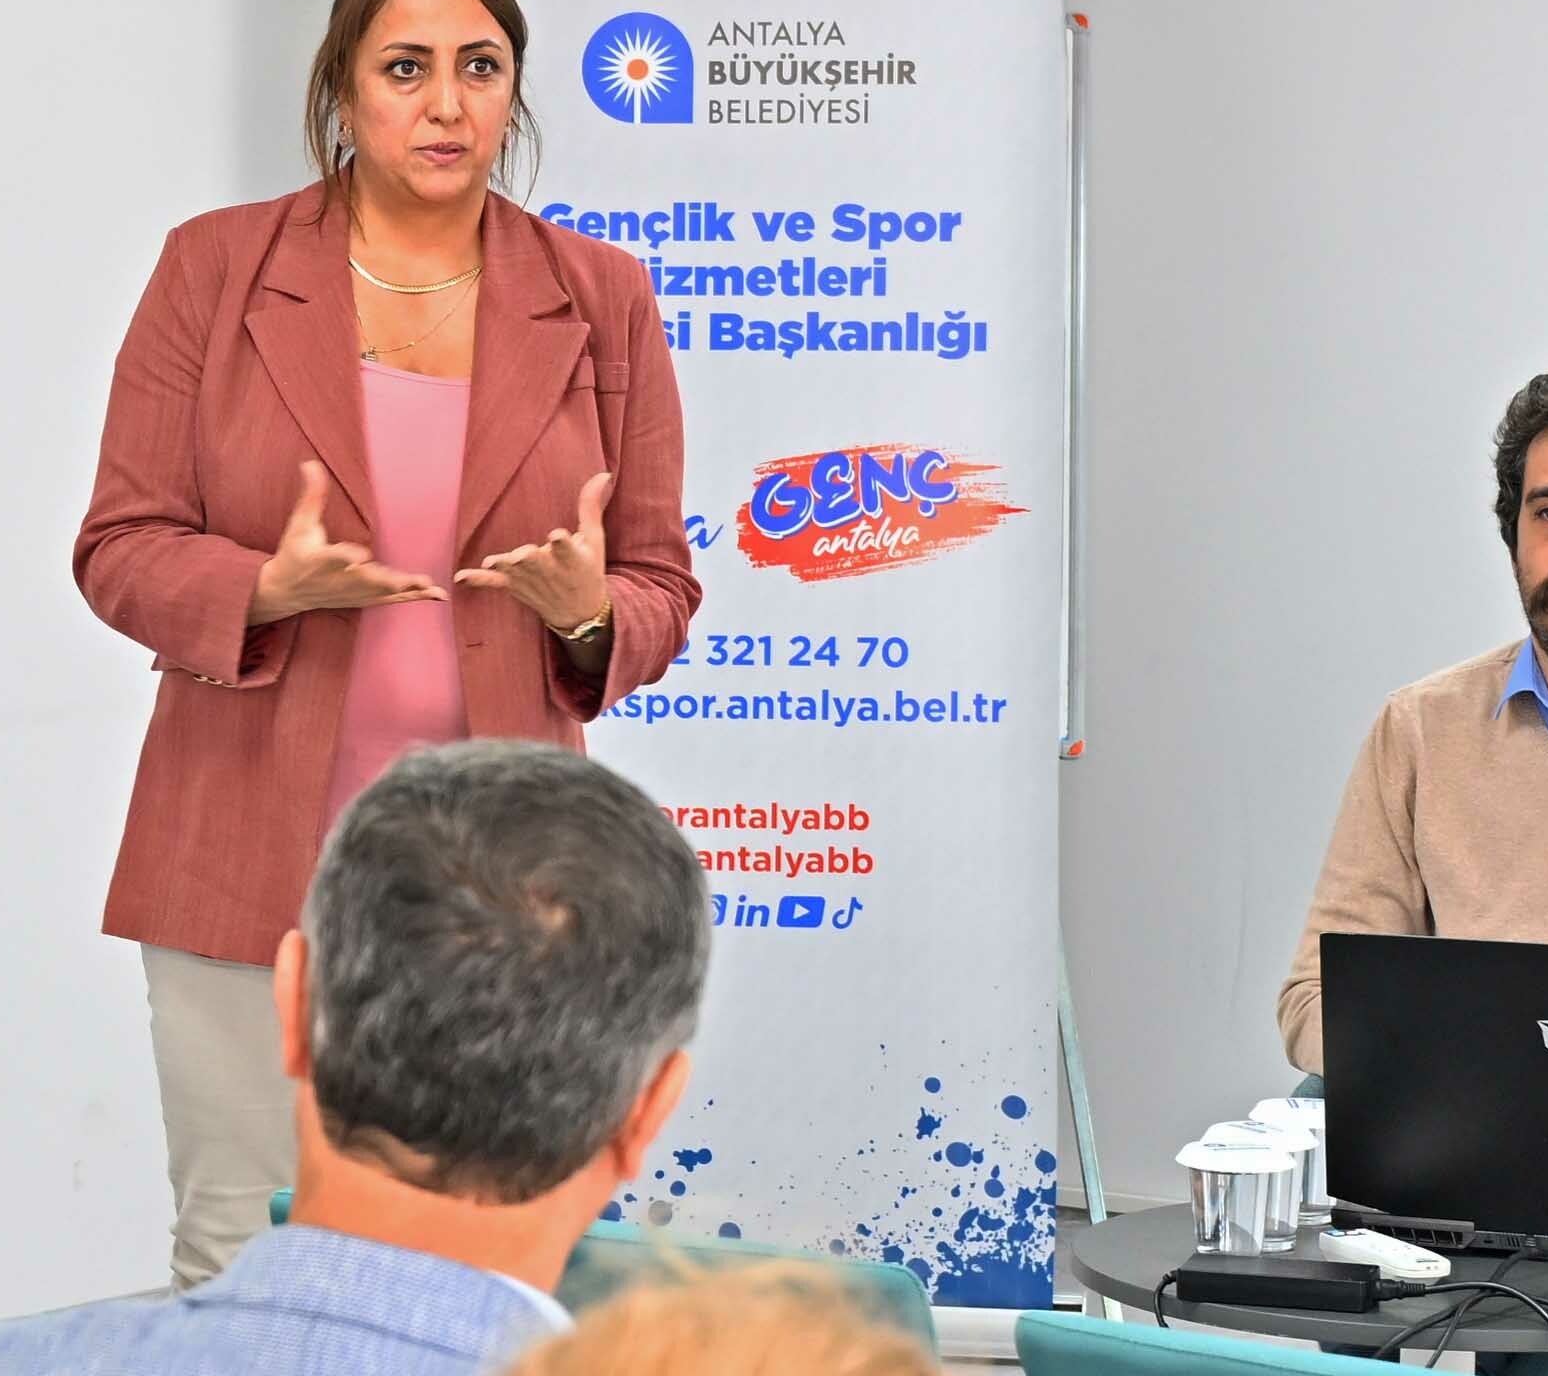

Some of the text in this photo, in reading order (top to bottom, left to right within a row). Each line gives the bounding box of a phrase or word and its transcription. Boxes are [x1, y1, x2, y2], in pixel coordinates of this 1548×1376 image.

[707, 21, 846, 47] ANTALYA
[707, 51, 917, 90] BÜYÜKŞEHİR
[708, 91, 870, 124] BELEDİYESİ
[752, 212, 815, 242] ve
[831, 203, 962, 251] Spor
[649, 256, 888, 297] izmetleri
[709, 309, 988, 360] Başkanlığı
[750, 449, 958, 539] GENÇ
[813, 517, 920, 558] antalya
[705, 634, 772, 667] 321
[788, 635, 841, 667] 24
[856, 636, 910, 669] 70
[698, 845, 874, 877] antalyabb
